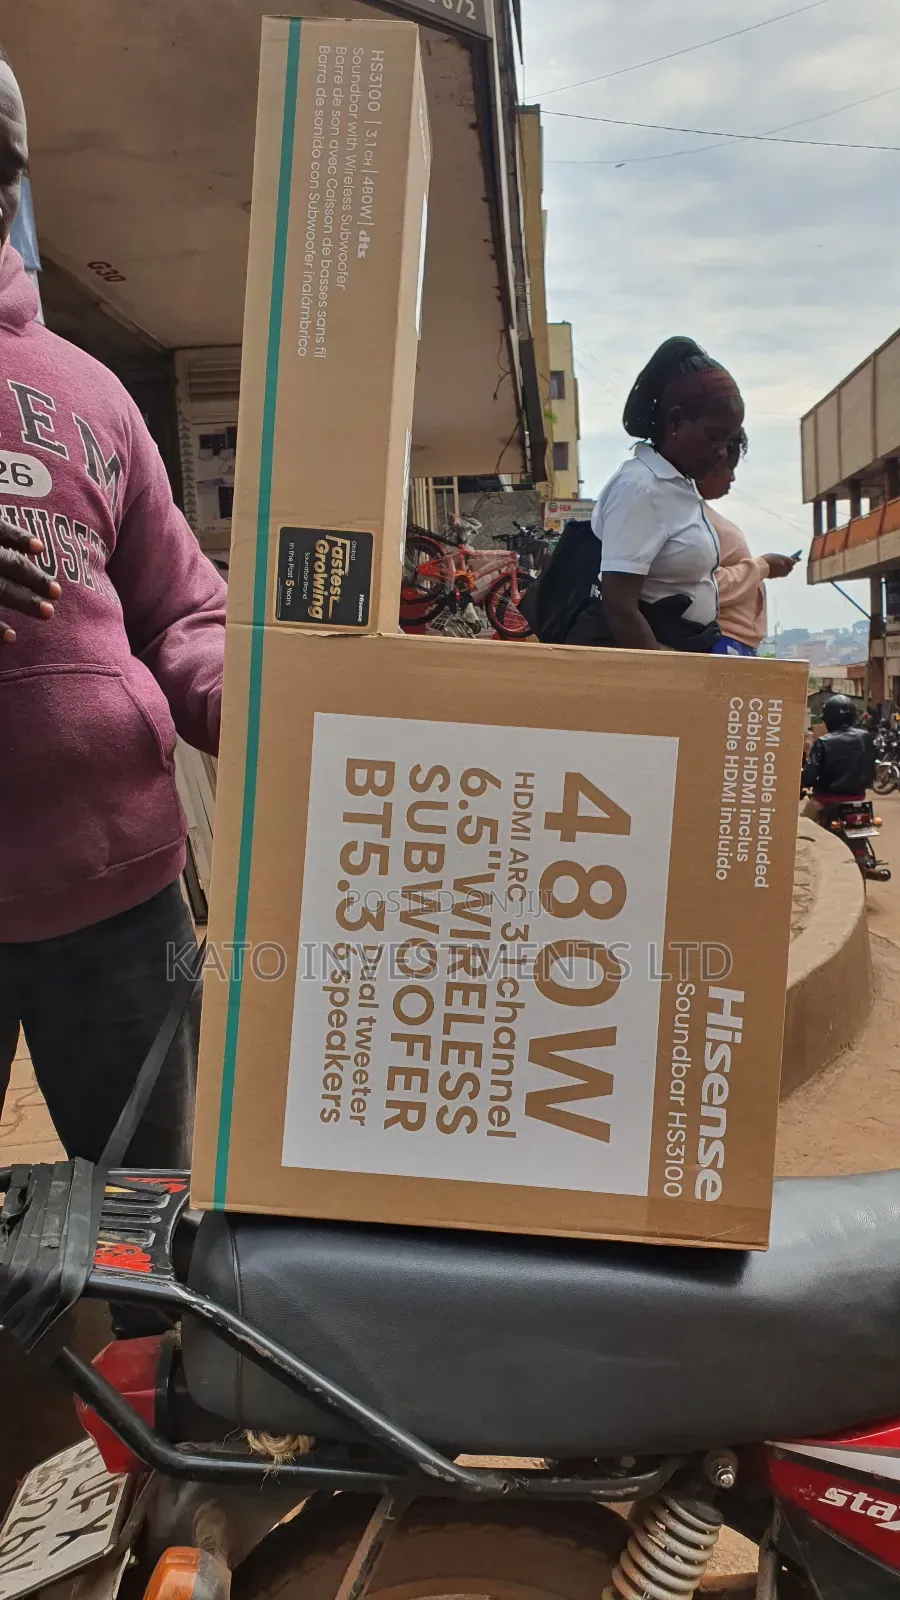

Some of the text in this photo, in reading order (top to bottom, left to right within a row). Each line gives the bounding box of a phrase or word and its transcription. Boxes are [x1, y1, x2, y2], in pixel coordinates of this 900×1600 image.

[368, 49, 385, 112] HS3100
[297, 45, 331, 357] Barra de sonido con Subwoofer inalámbrico
[313, 46, 347, 358] Barre de son avec Caisson de basses sans fil
[335, 47, 364, 290] Soundbar with Wireless Subwoofer
[357, 230, 371, 259] dts
[360, 176, 374, 220] 480W
[285, 579, 295, 587] 5
[285, 587, 293, 606] Years
[303, 551, 311, 581] Soundbar
[307, 539, 330, 620] Growing
[325, 534, 351, 619] Fastest
[357, 593, 365, 623] Hisense
[335, 757, 396, 932] BT5.3
[510, 771, 535, 841] HDMI
[715, 696, 744, 881] Cable HDMI incluido
[736, 697, 763, 862] Câble HDMI inclus
[754, 699, 783, 888] HDMI cable included
[383, 763, 451, 1132] SUBWOOFER
[506, 847, 530, 903] ARC
[319, 942, 358, 1123] 6 speakers
[349, 945, 383, 1126] Dual tweeter
[524, 771, 632, 1144] 480W
[487, 976, 526, 1139] channel
[663, 982, 696, 1198] Soundbar HS3100
[694, 985, 745, 1202] Hisense
[818, 1487, 900, 1531] sta
